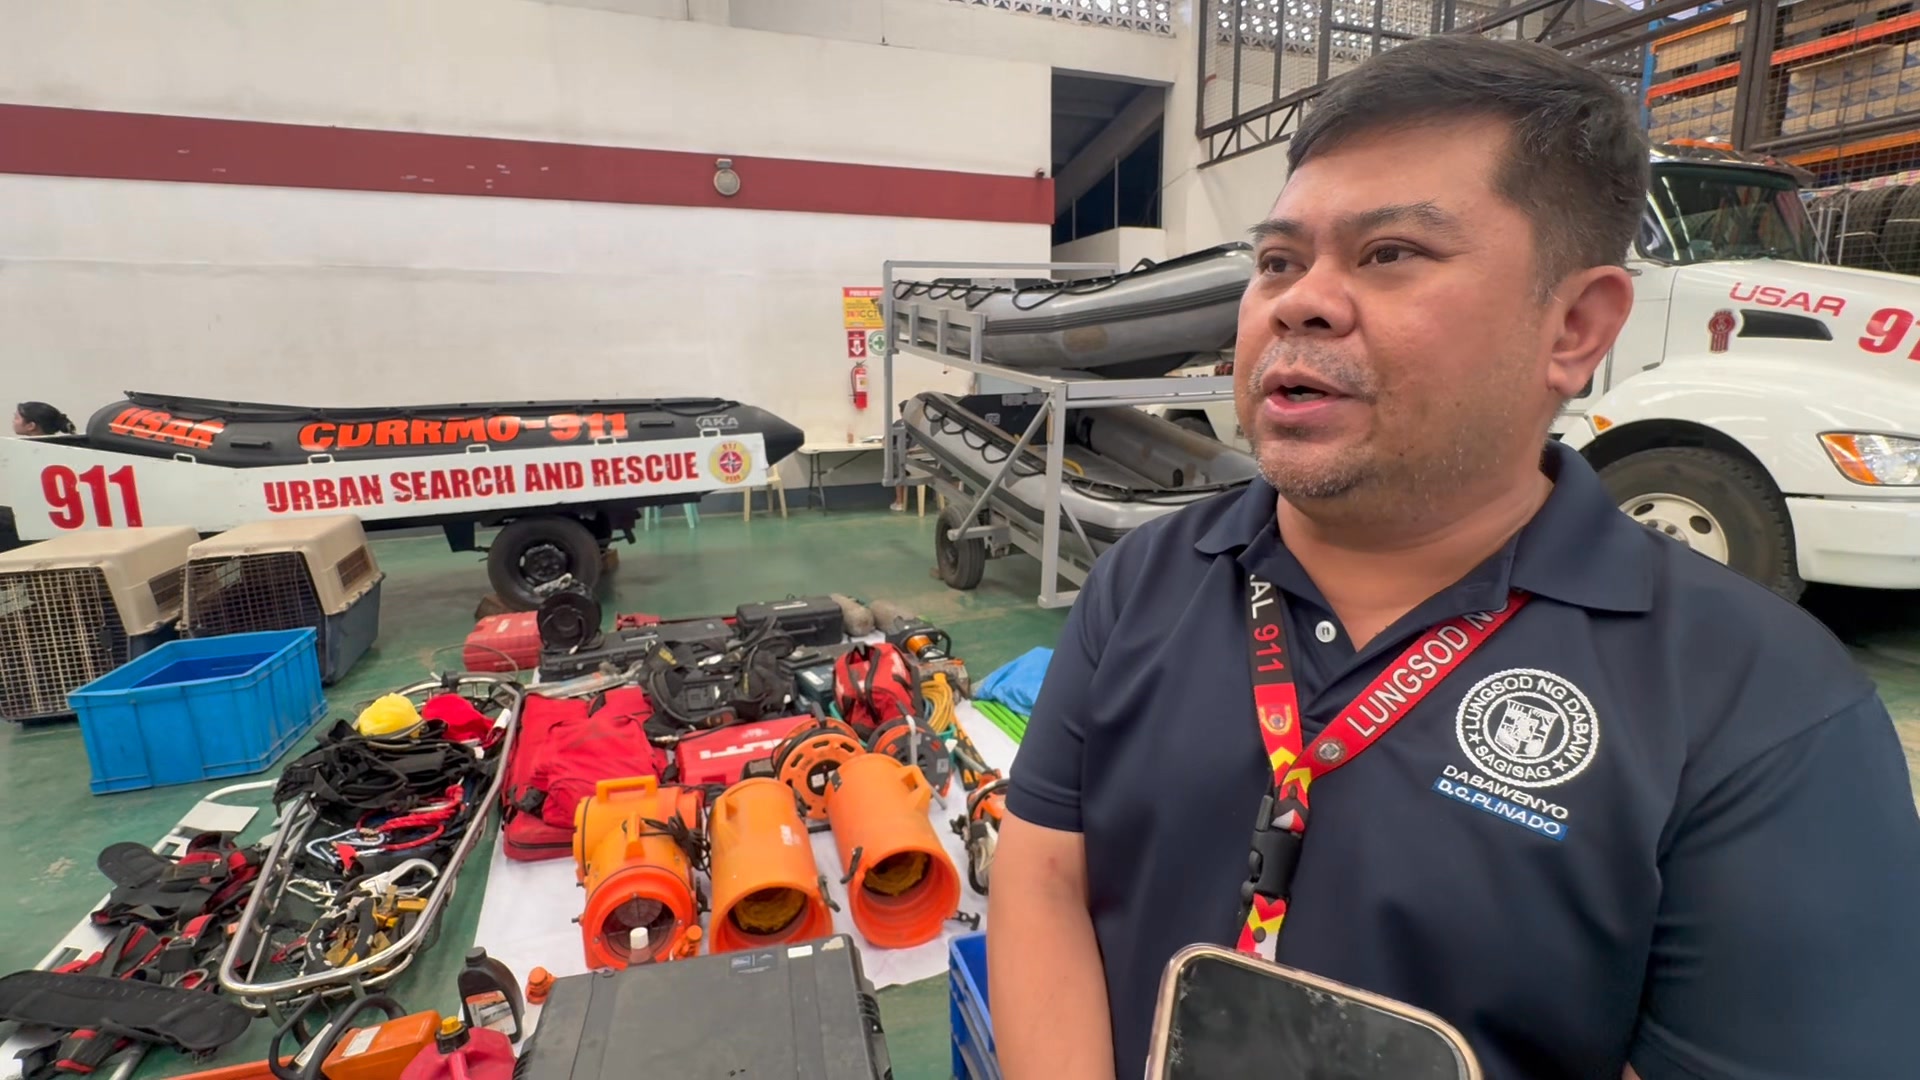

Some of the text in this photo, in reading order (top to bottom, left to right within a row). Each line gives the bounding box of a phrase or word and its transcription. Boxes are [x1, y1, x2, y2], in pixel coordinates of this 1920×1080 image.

[1729, 282, 1920, 362] USAR 9
[41, 464, 143, 529] 911
[263, 452, 699, 513] URBAN SEARCH AND RESCUE
[1249, 574, 1285, 672] AL 911
[1346, 625, 1469, 738] LUNGSOD
[1465, 675, 1590, 765] LUNGSOD NG DABAW
[1443, 764, 1569, 820] DABAWENYO
[1474, 744, 1552, 780] SAGISAG
